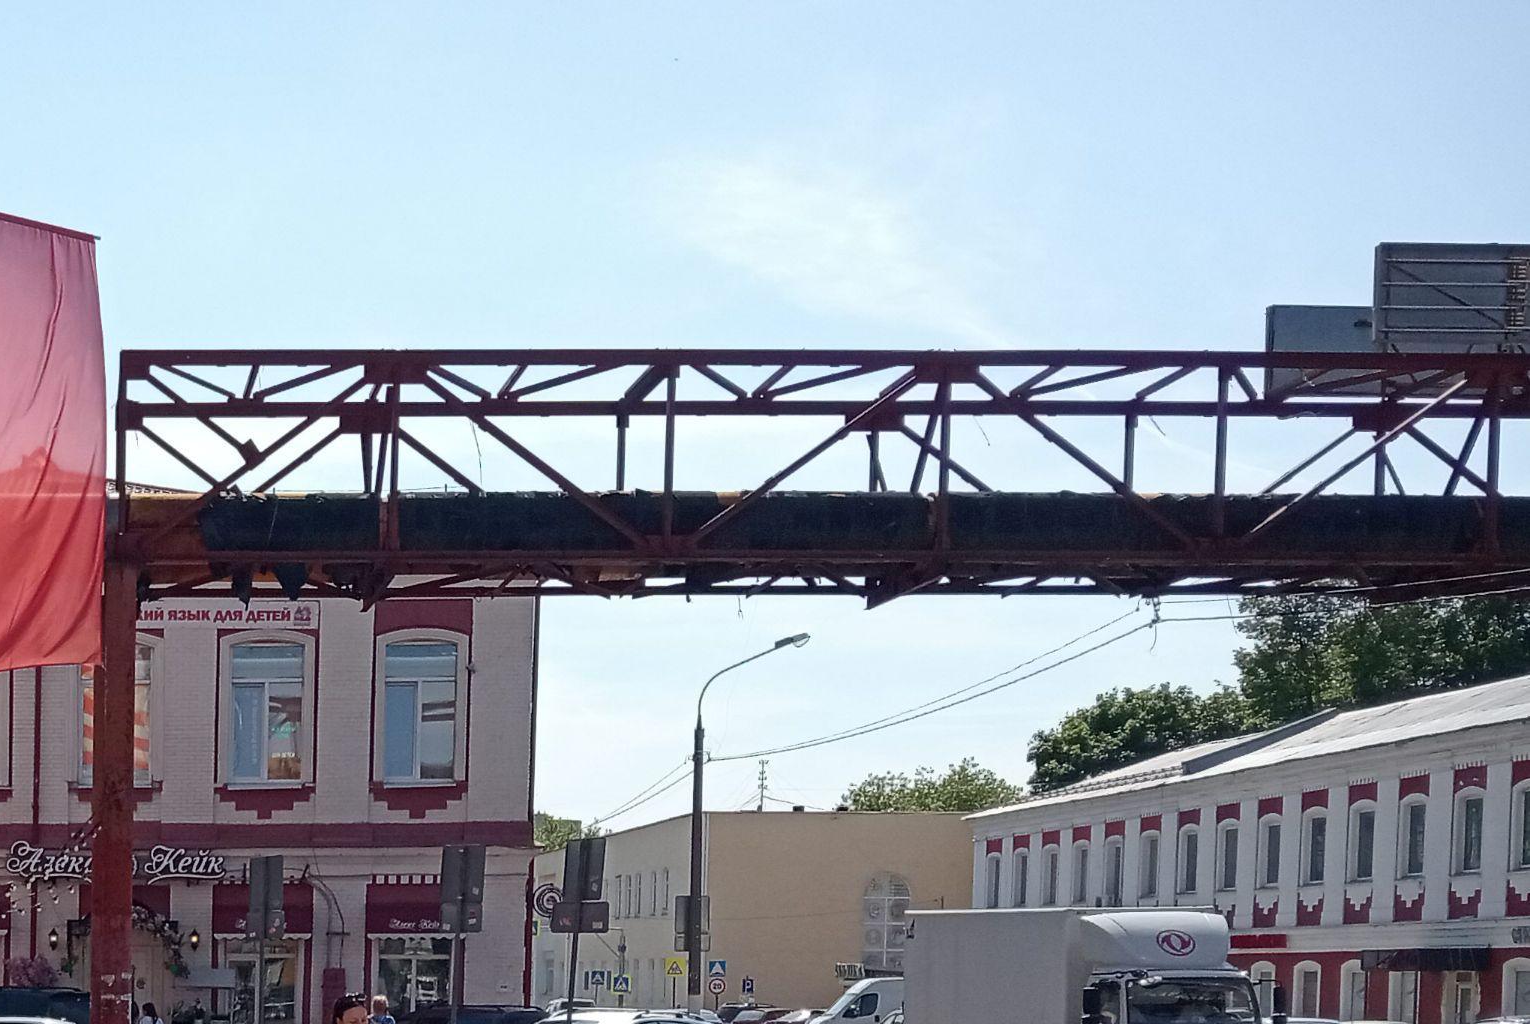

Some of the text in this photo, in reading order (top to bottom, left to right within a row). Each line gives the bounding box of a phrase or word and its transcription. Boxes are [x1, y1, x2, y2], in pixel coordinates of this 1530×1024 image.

[168, 610, 210, 622] ЯЗЫК
[213, 609, 243, 624] ДЛЯ
[245, 607, 291, 624] ДЕТЕЙ
[144, 844, 226, 886] Кейк
